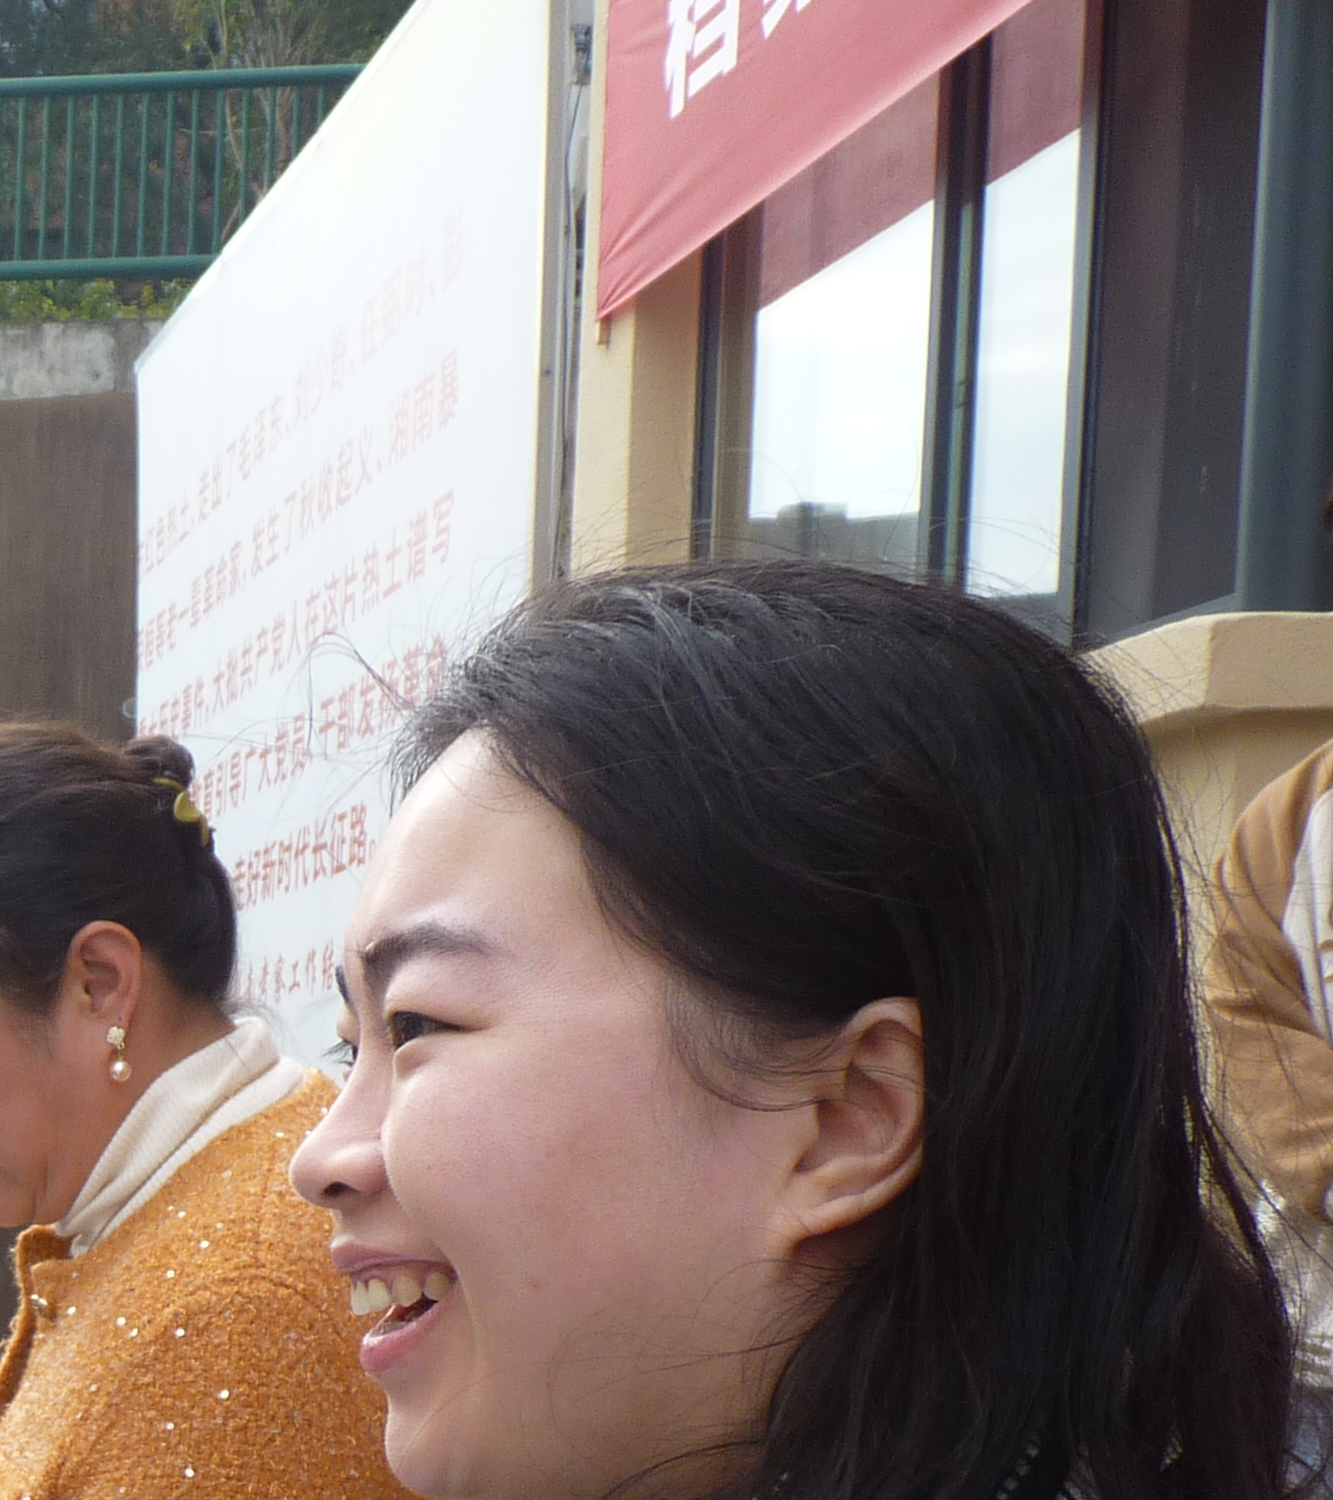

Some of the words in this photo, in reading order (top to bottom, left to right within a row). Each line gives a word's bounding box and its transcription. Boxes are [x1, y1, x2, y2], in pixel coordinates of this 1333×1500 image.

[140, 203, 465, 578] 红色热土，走出了毛泽东、刘少奇、任弼时、彭
